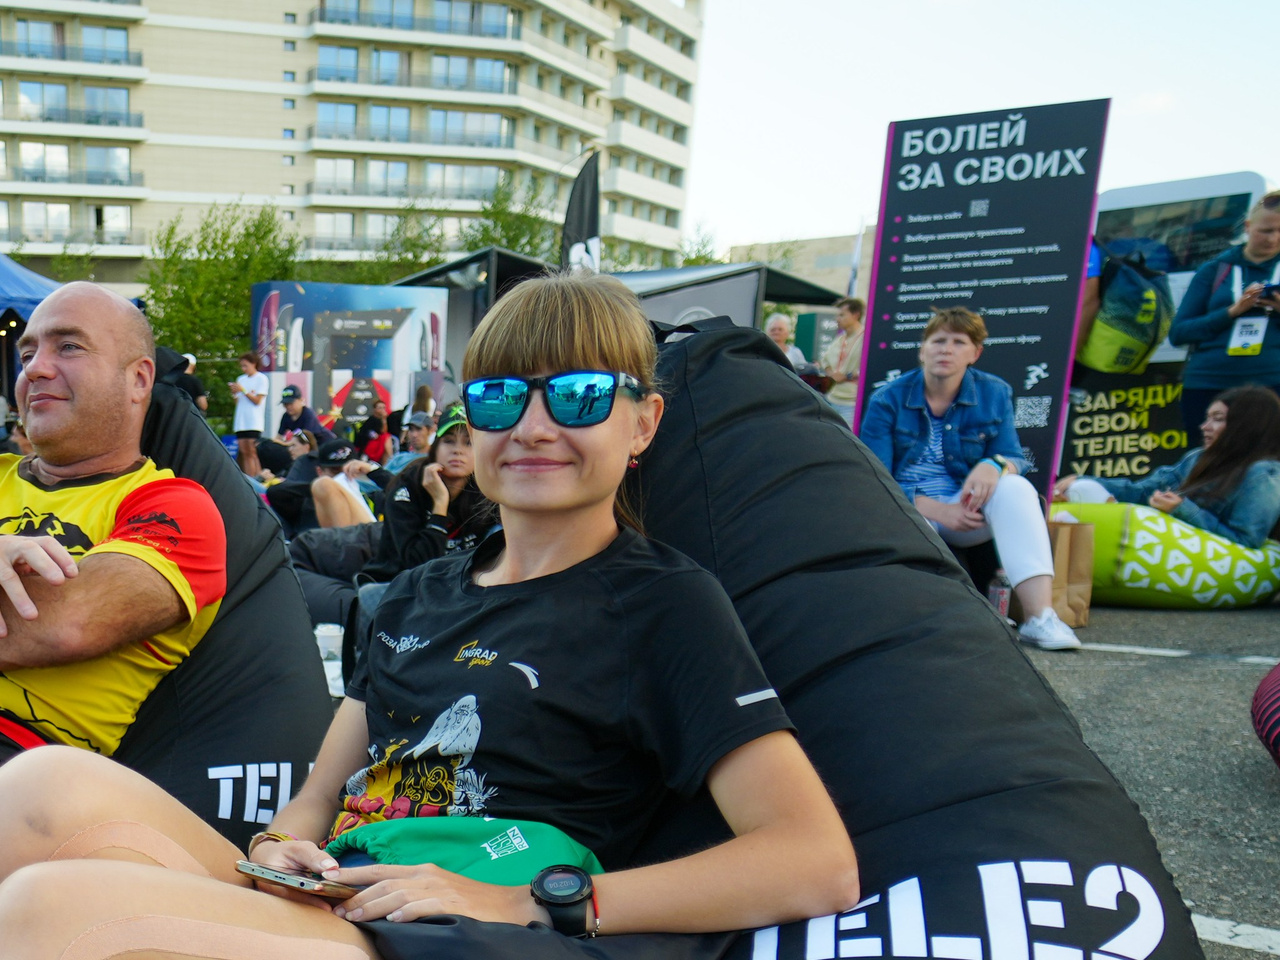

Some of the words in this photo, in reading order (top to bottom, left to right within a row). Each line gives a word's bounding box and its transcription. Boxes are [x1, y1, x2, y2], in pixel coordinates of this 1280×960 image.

[901, 113, 1027, 158] БОЛЕЙ
[897, 161, 945, 191] ЗА
[954, 147, 1088, 186] СВОИХ
[1073, 406, 1150, 435] СВОЙ
[1094, 455, 1151, 478] НАС
[376, 631, 398, 649] РОЗА
[460, 647, 499, 662] INGRAD
[207, 762, 315, 825] TEL
[508, 828, 528, 851] RUN
